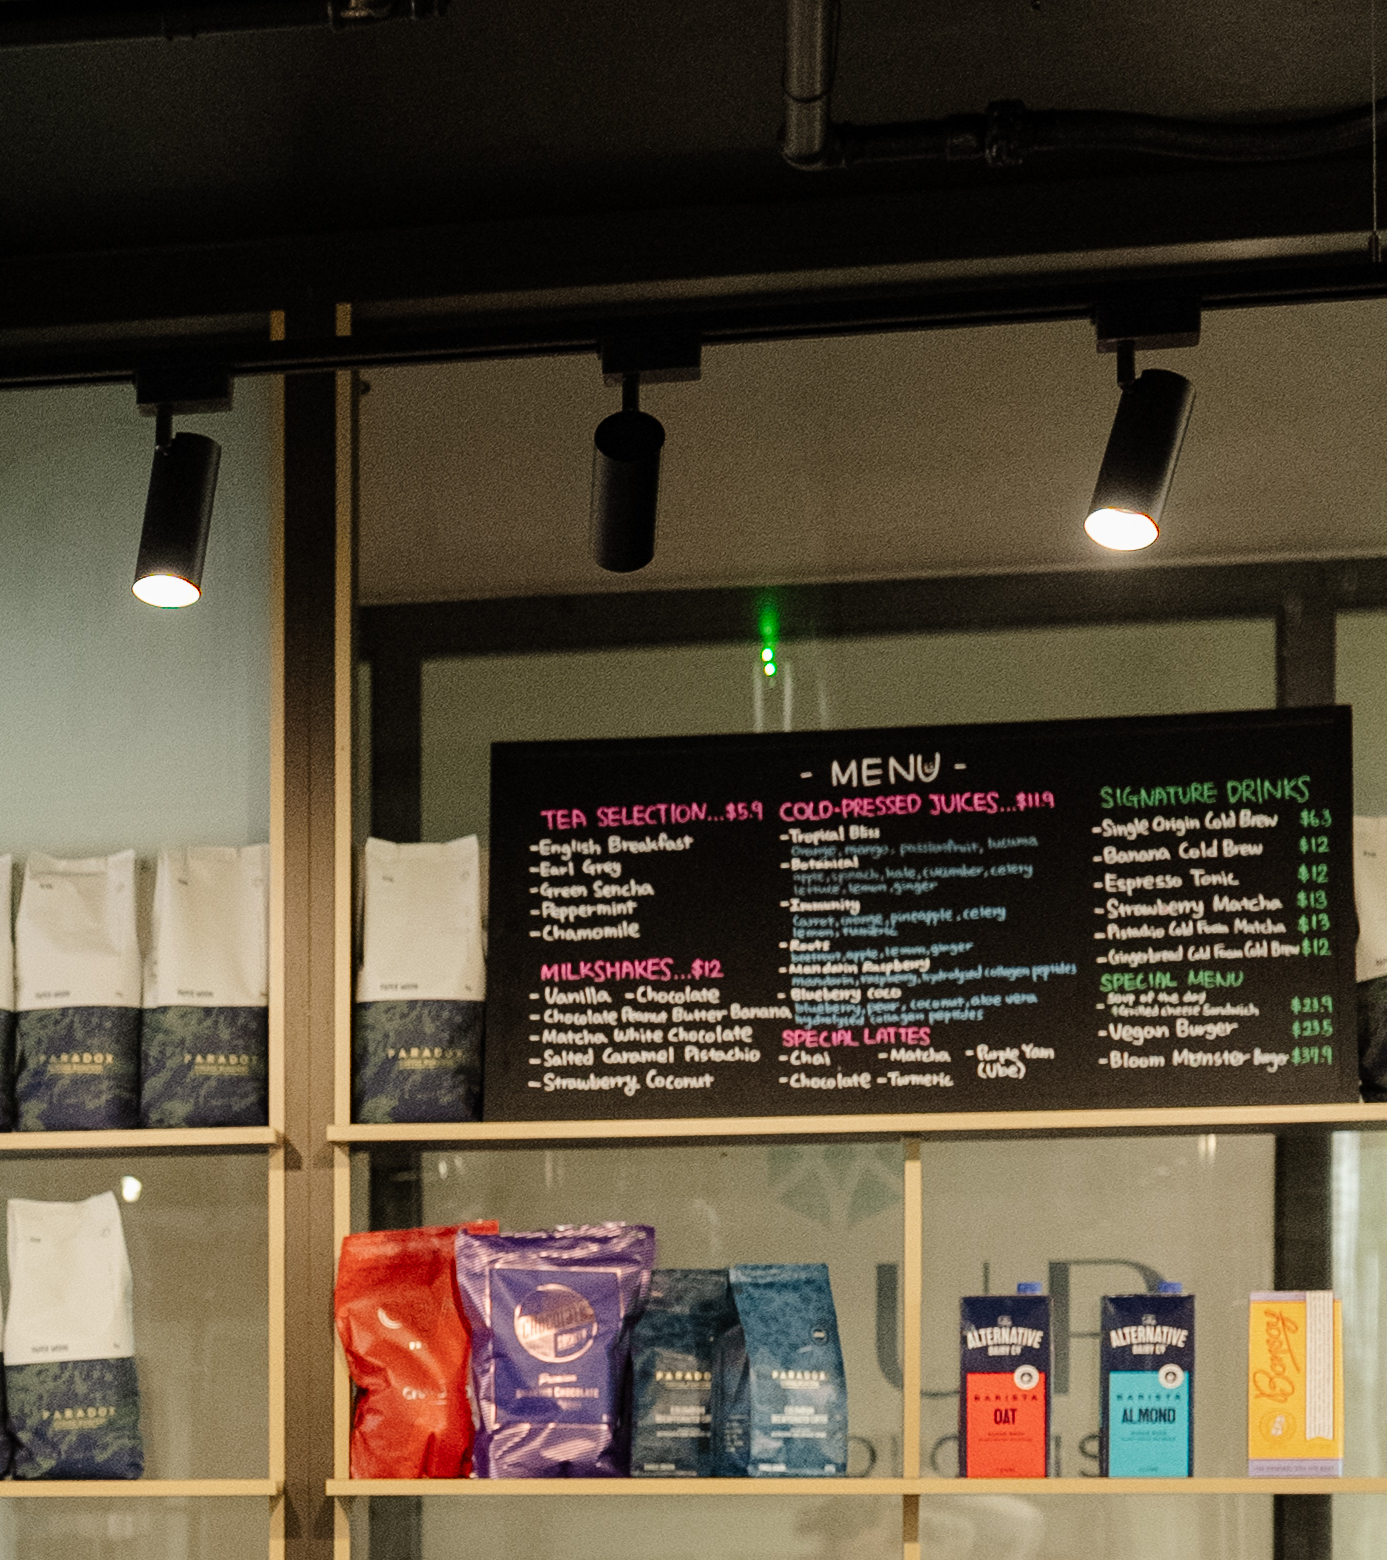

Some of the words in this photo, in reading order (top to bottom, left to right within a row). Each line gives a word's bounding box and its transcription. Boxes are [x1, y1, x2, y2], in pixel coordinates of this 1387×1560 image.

[830, 752, 941, 787] MENU
[1100, 781, 1217, 809] SIGNATURE
[1227, 775, 1311, 804] DRINKS
[779, 793, 922, 822] COLD-PRESSED
[540, 808, 587, 830] TEA
[1101, 817, 1149, 840] Single
[1152, 815, 1200, 837] Origin
[1205, 809, 1237, 830] Cold
[1239, 808, 1279, 828] Brew
[539, 839, 601, 861] English
[608, 832, 694, 854] Breakfast
[1102, 845, 1171, 864] Banana
[1178, 839, 1218, 860] Cold
[1222, 838, 1263, 858] Brew
[1299, 835, 1330, 855] $12
[539, 860, 575, 877] Earl
[582, 858, 622, 878] Grey
[540, 881, 588, 899] Green
[593, 878, 655, 898] Sencha
[1104, 872, 1182, 897] Espresso
[1189, 868, 1240, 887] Tonic
[1297, 863, 1329, 884] $12
[541, 900, 638, 923] Peppermint
[1106, 898, 1205, 920] Strawberry
[1212, 893, 1283, 913] Matcha
[542, 920, 641, 942] Chamomile
[1099, 972, 1177, 992] SPECIAL
[1187, 969, 1245, 989] MENU
[544, 986, 612, 1005] Vanilla
[636, 985, 720, 1004] Chocolate
[543, 1008, 618, 1026] Chocolate
[671, 1006, 728, 1023] Butter
[730, 1002, 793, 1020] Banana
[542, 1028, 609, 1045] Matcha
[613, 1027, 663, 1043] White
[667, 1024, 754, 1043] Chocolate
[781, 1029, 859, 1048] SPECIAL
[863, 1026, 931, 1046] LATTES
[1108, 1022, 1170, 1046] Vegan
[1175, 1018, 1239, 1040] Burger
[543, 1047, 594, 1068] Salted
[602, 1046, 674, 1064] Caramel
[684, 1045, 761, 1063] Pistachio
[789, 1050, 831, 1066] Chai
[889, 1047, 952, 1063] Matcha
[1109, 1050, 1165, 1068] Bloom
[1172, 1048, 1252, 1068] Monster
[789, 1072, 872, 1090] Chocolate
[887, 1071, 954, 1087] Turmeric
[977, 1062, 1026, 1080] (Ube)
[542, 1072, 641, 1097] Strawberry
[645, 1068, 714, 1089] Coconut
[966, 1326, 1044, 1350] ALTERNATIVE
[1110, 1325, 1188, 1349] ALTERNATIVE
[994, 1408, 1017, 1425] OAT
[1121, 1408, 1176, 1424] ALMOND
